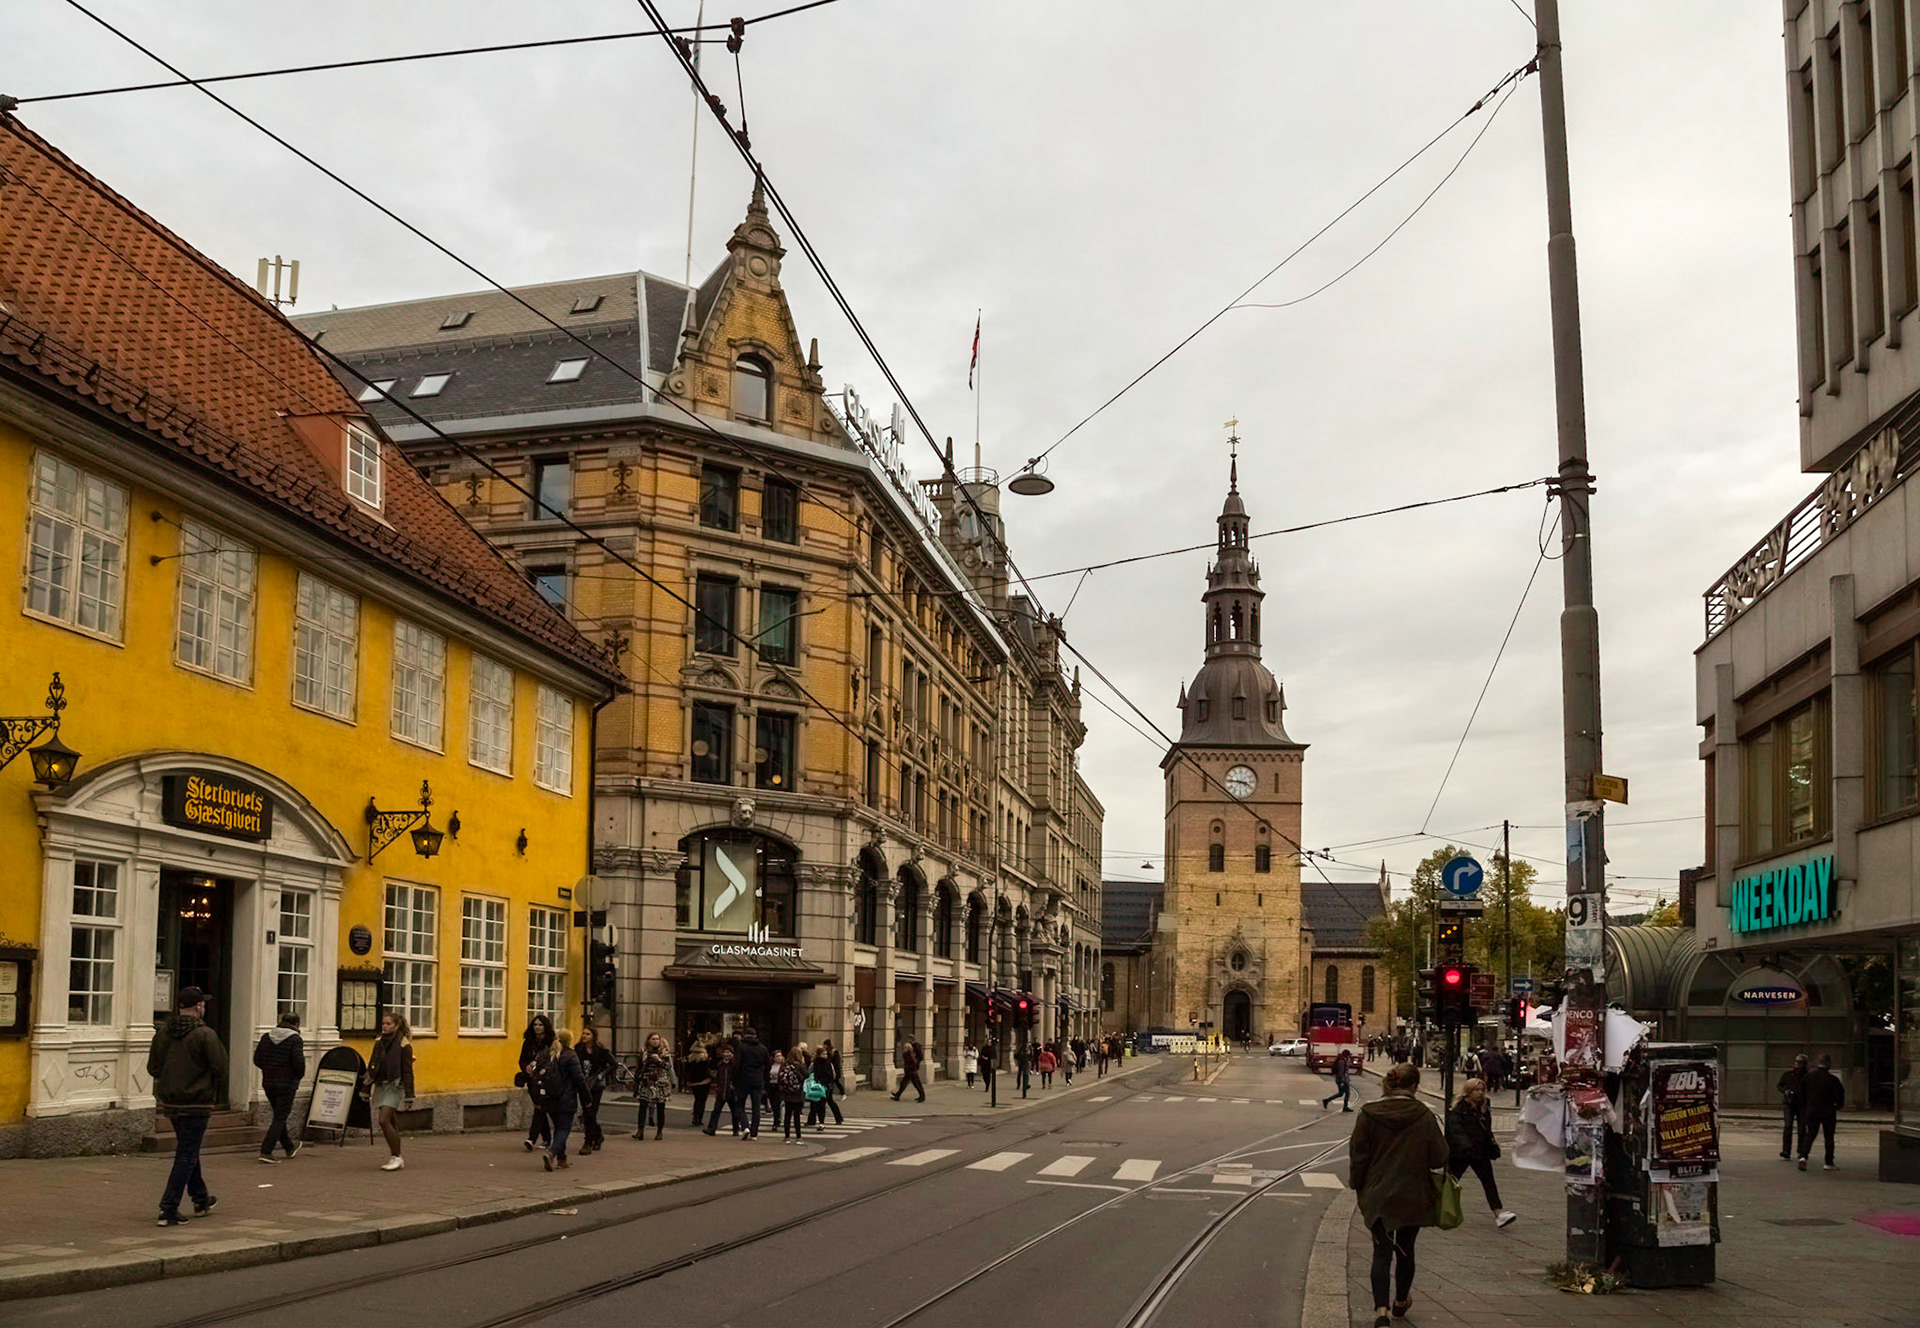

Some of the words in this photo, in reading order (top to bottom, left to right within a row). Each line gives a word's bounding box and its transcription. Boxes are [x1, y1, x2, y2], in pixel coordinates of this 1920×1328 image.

[184, 798, 261, 832] Gjæstgiveri
[1732, 857, 1831, 932] WEEKDAY
[711, 944, 803, 957] GLASMAGASINET
[1743, 991, 1796, 999] NARVESEN
[1660, 1127, 1688, 1141] VILLAGE
[1688, 1121, 1712, 1135] PEOPLE
